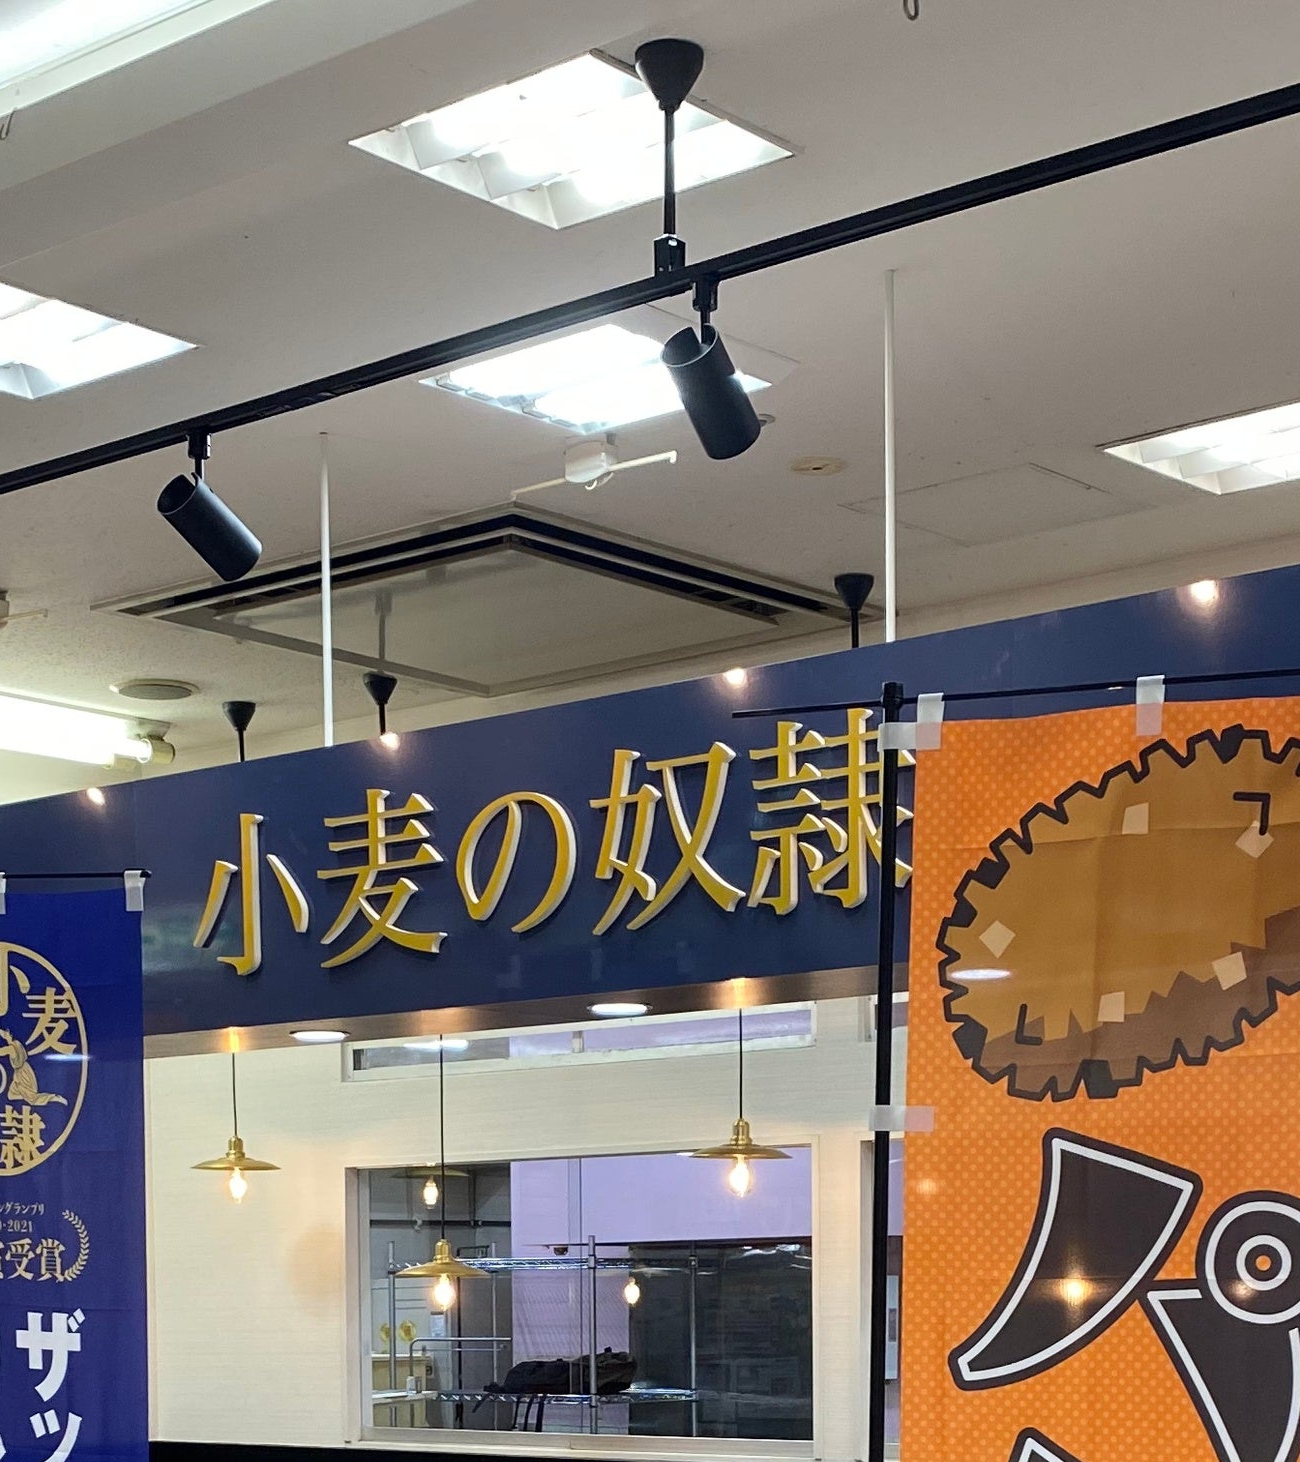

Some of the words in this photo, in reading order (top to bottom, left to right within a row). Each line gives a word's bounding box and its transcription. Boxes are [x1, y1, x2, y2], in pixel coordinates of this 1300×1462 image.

[194, 708, 913, 975] 小麦の奴隷
